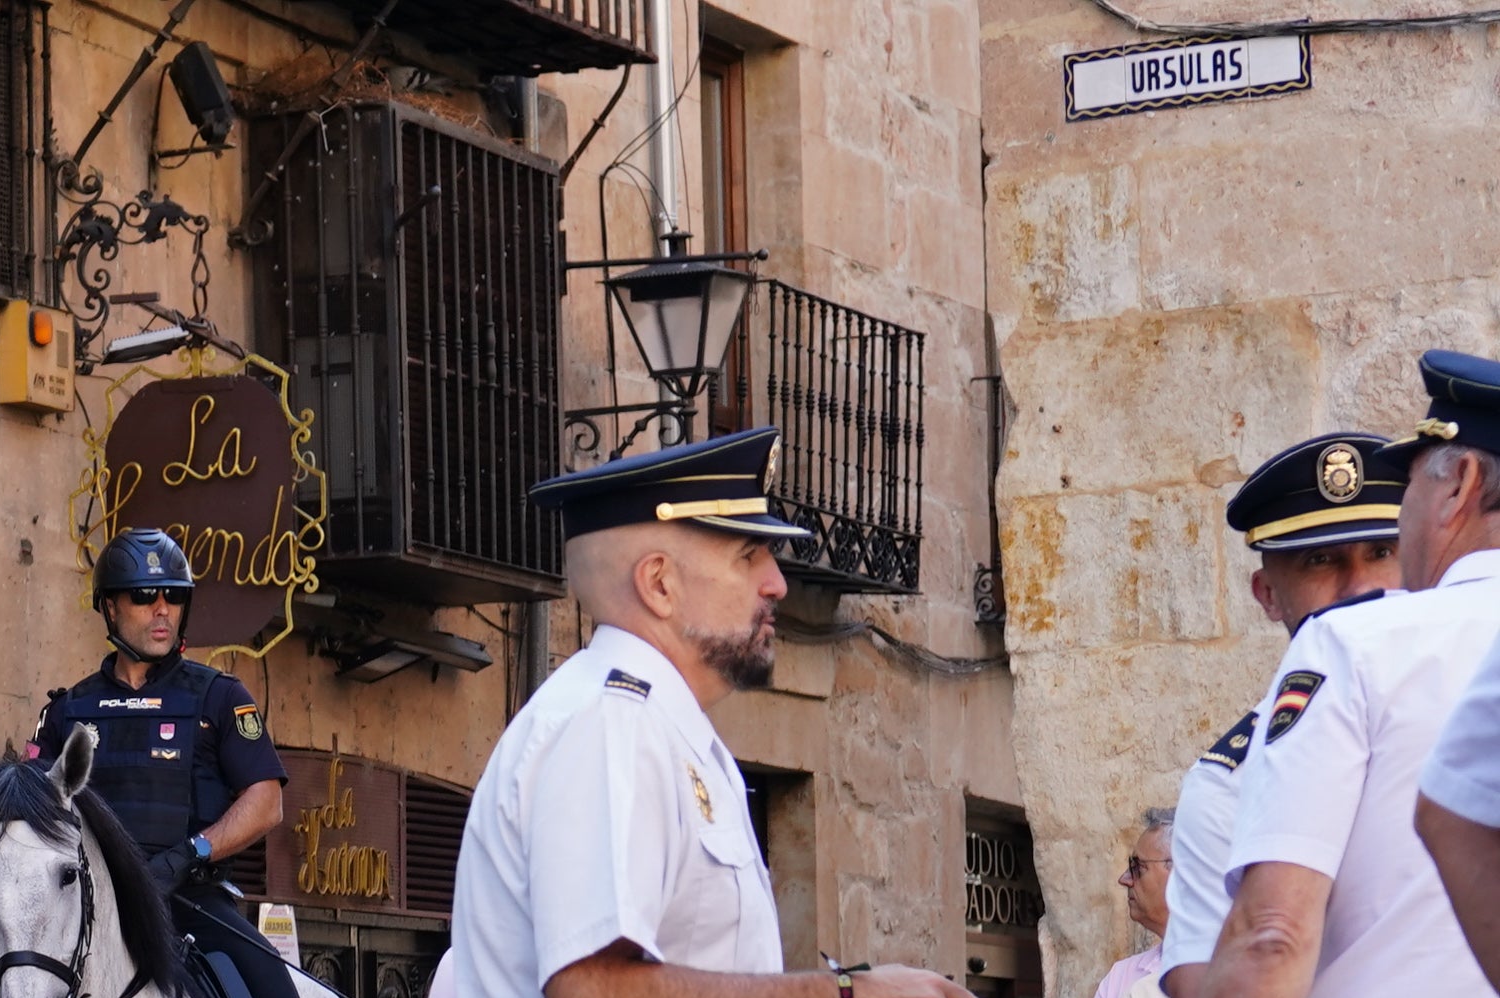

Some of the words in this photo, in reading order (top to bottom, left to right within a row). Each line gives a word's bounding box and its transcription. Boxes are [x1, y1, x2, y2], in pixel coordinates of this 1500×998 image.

[1131, 47, 1243, 93] URSULAS
[163, 395, 257, 486] La
[99, 698, 148, 708] POLICIA
